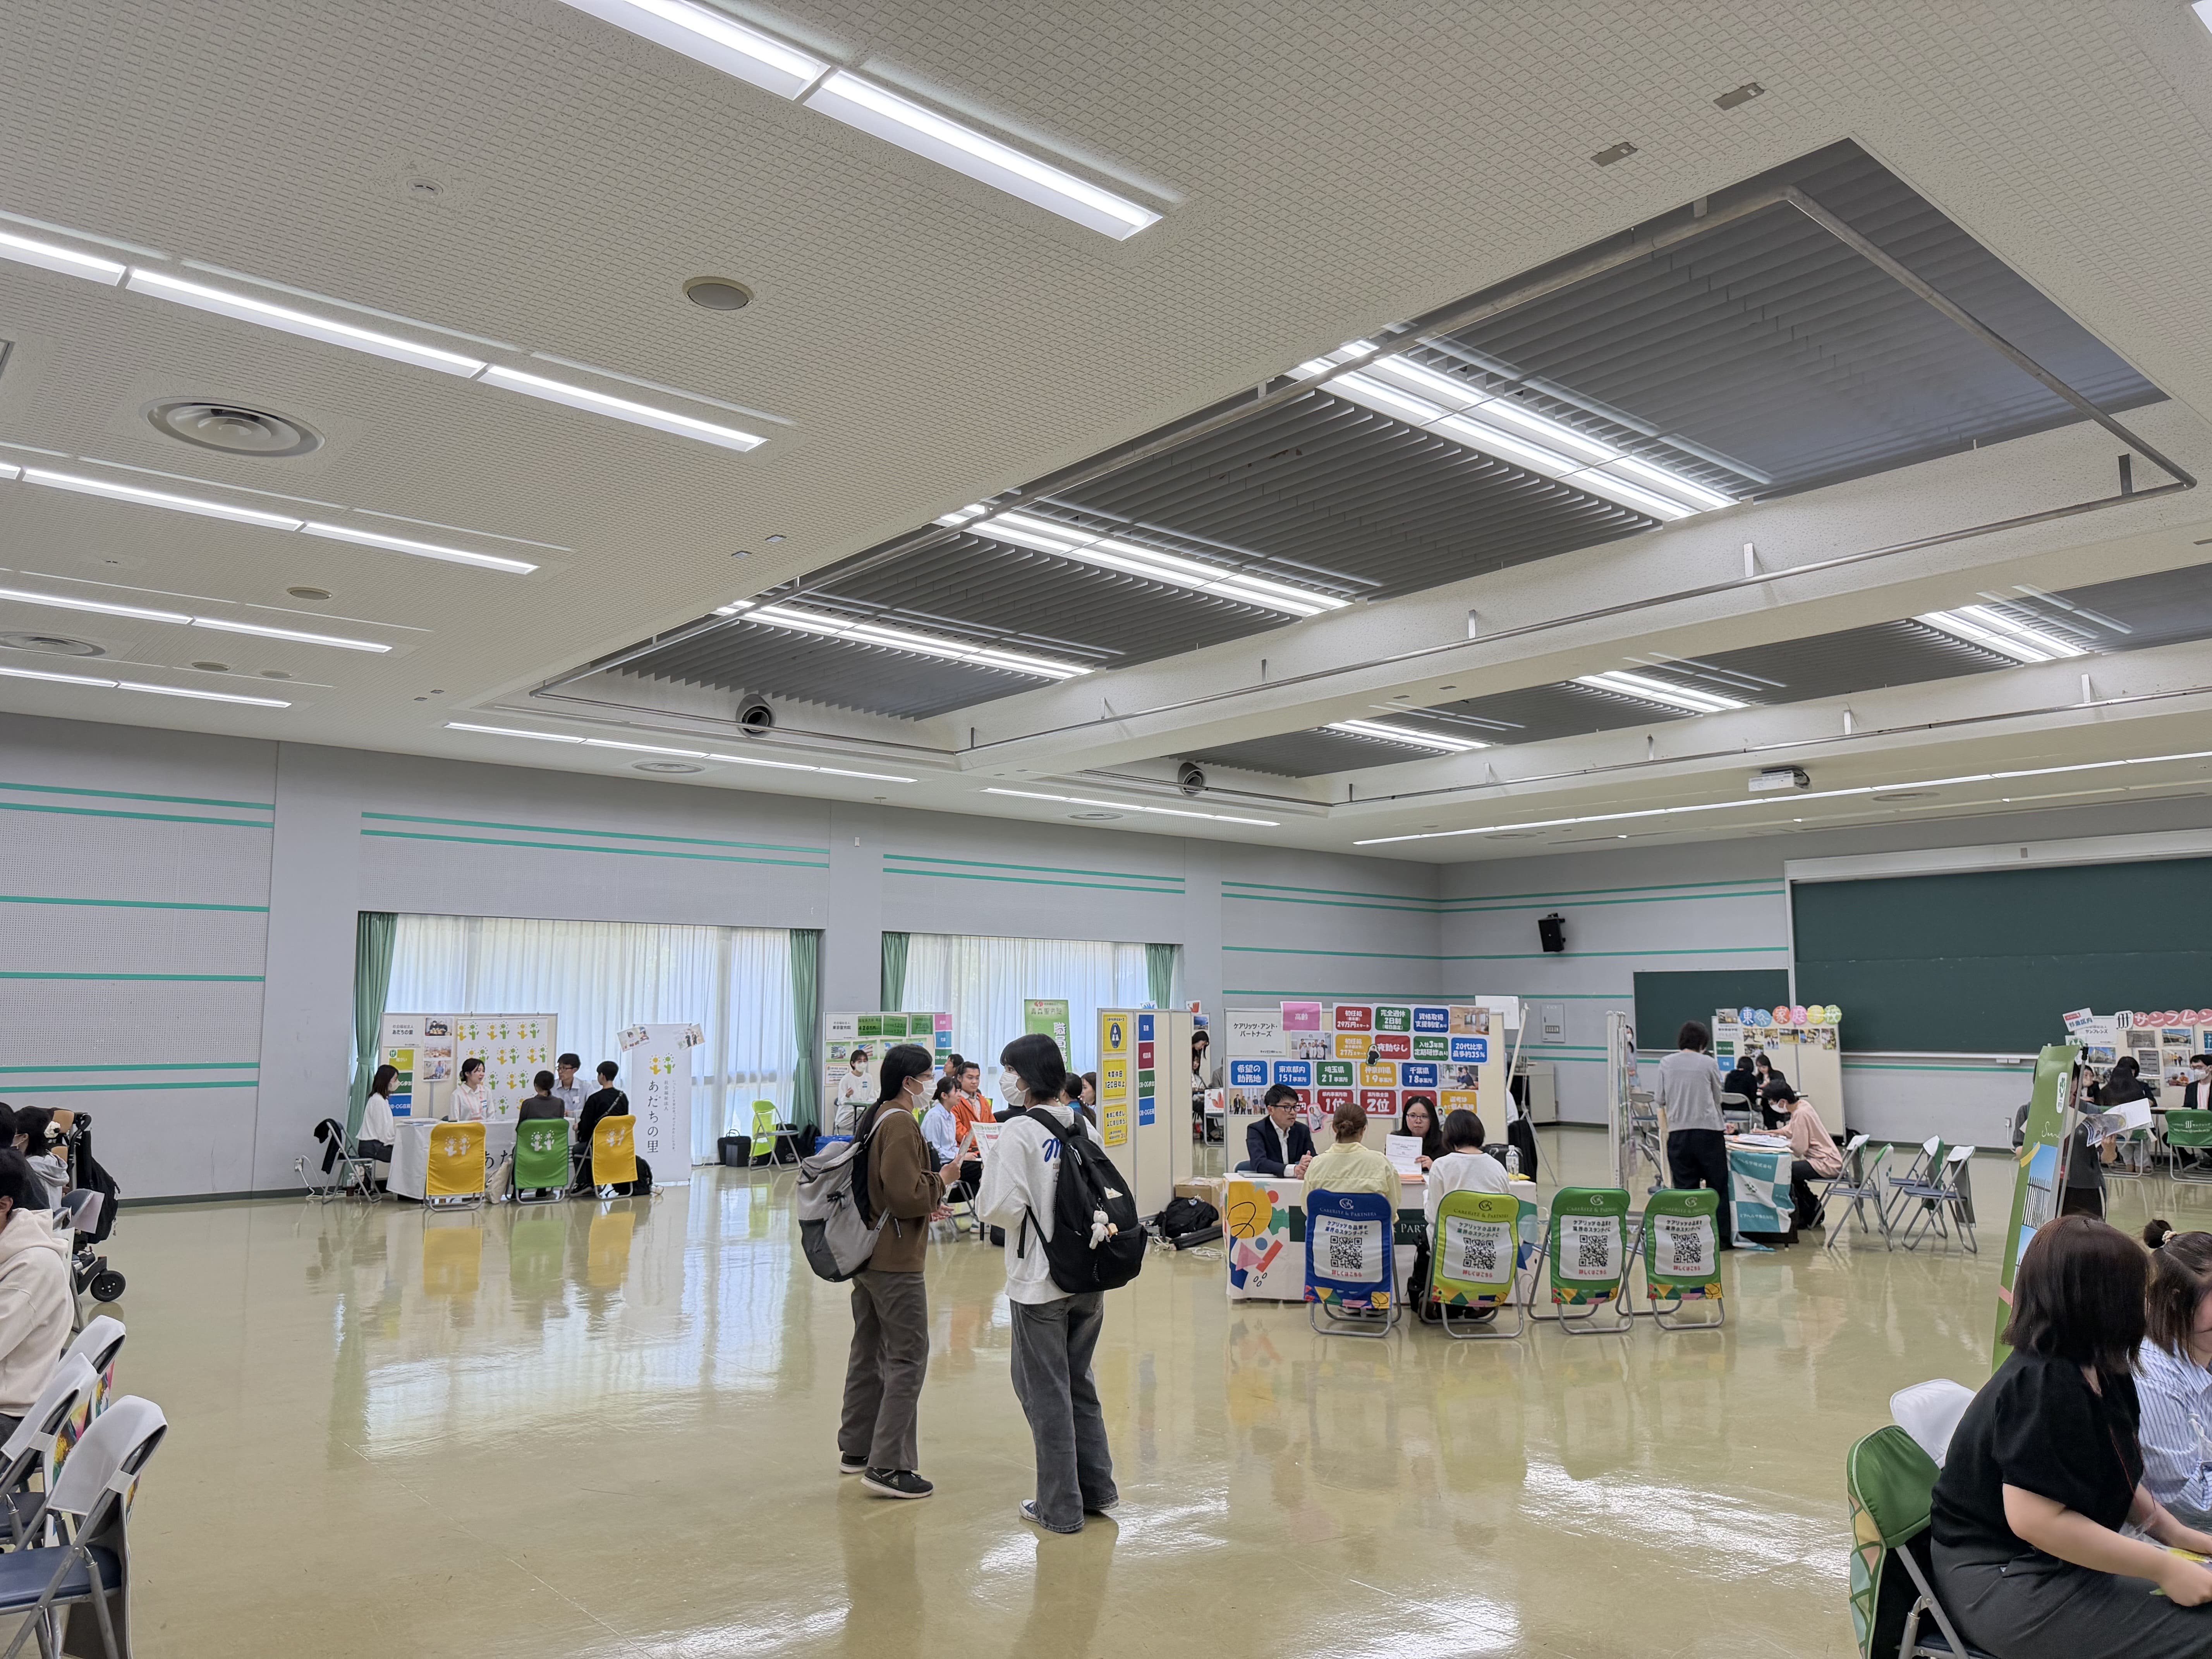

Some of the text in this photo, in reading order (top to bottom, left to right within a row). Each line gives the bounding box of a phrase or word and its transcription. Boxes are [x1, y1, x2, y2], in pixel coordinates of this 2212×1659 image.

[1377, 1043, 1408, 1052] 夜勤なし
[1237, 1065, 1261, 1073] 希望の
[1237, 1074, 1261, 1083] 勤務地
[1279, 1074, 1307, 1082] 151事業所
[1367, 1099, 1389, 1112] 2位
[647, 1080, 661, 1153] あだちの里
[1327, 1221, 1368, 1230] ケアリッツの品質を
